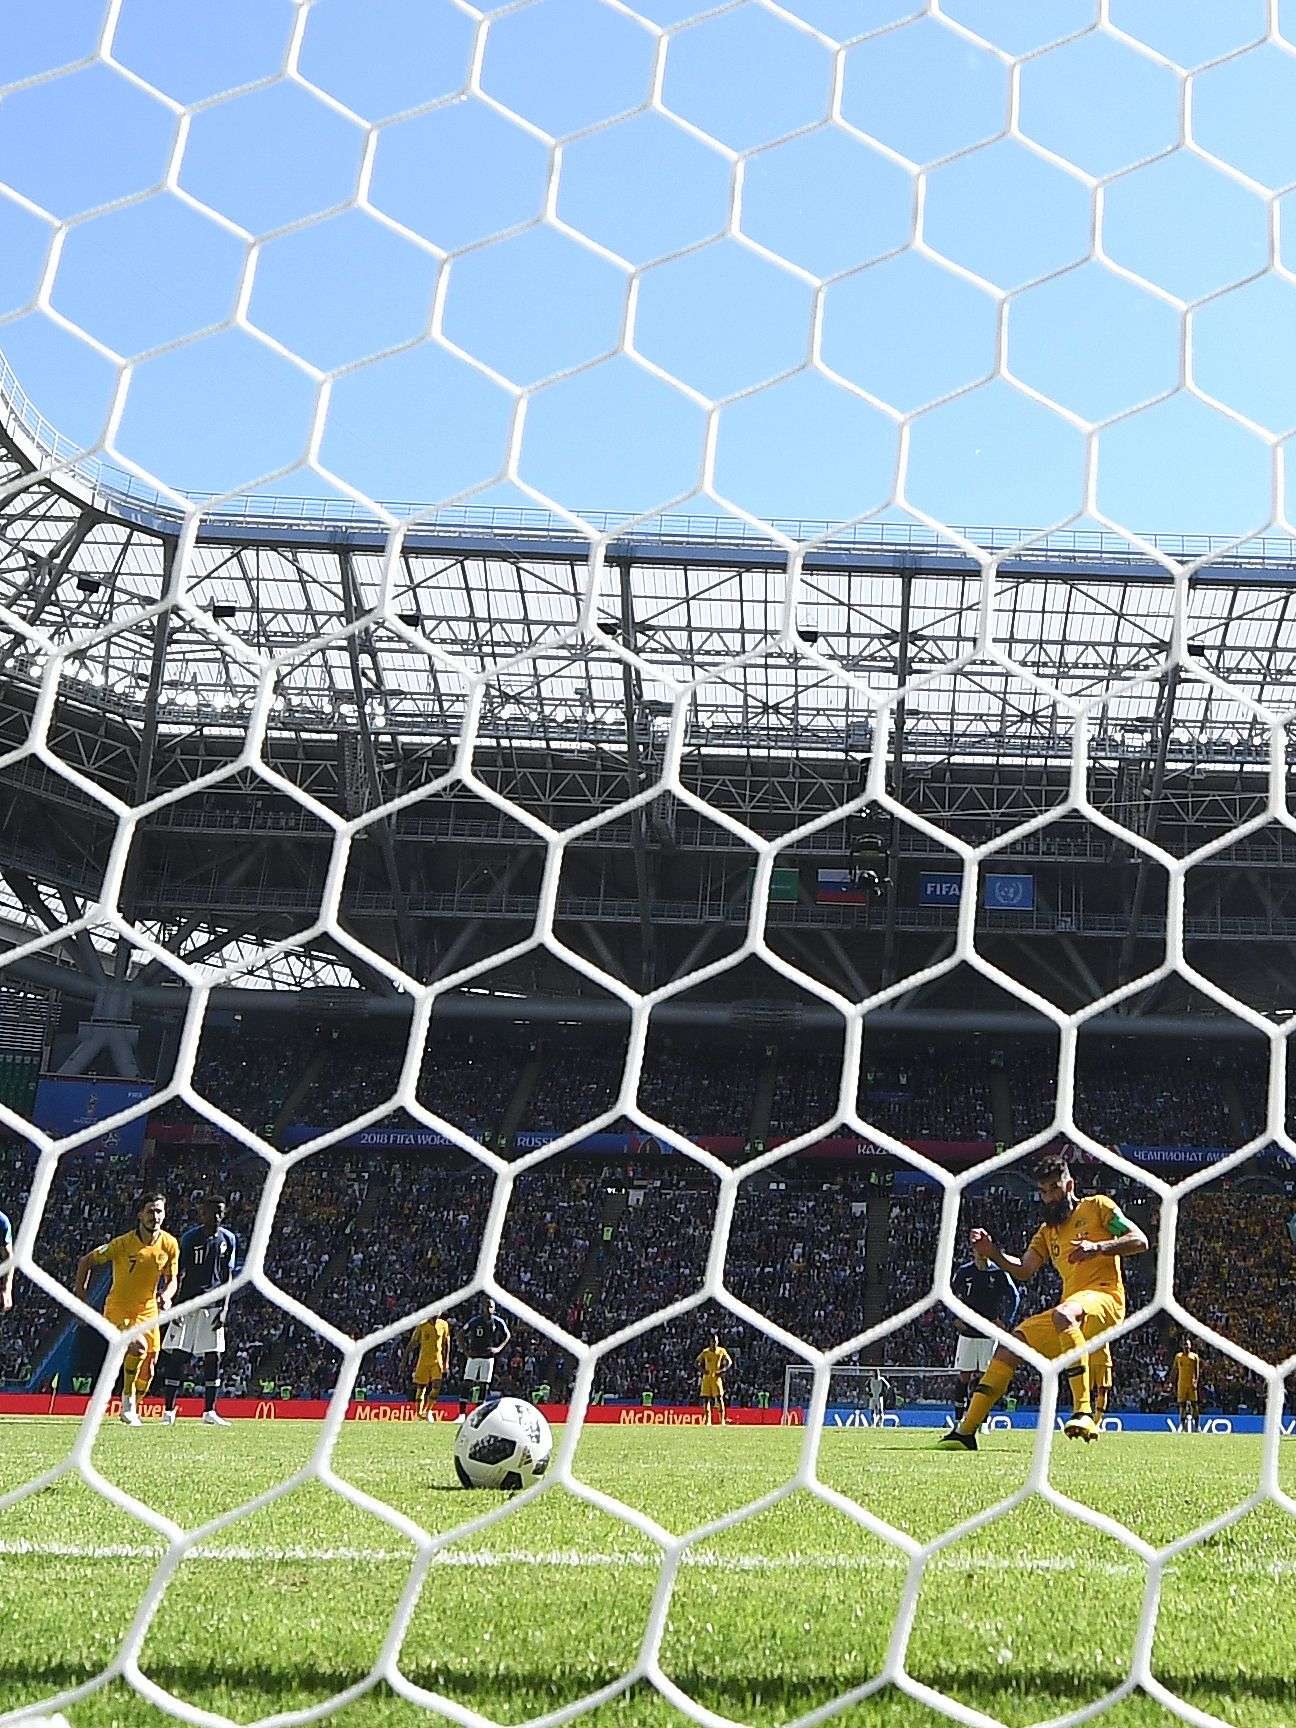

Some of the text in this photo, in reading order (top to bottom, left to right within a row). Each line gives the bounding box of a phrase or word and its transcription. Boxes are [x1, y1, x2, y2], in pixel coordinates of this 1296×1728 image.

[926, 883, 961, 896] FIFA
[360, 1133, 553, 1147] 2018 FIFA WORL RUSS
[194, 1249, 204, 1264] 11
[128, 1257, 137, 1273] 7
[966, 1283, 972, 1296] 7
[355, 1405, 447, 1421] McDelivy
[620, 1409, 708, 1425] McDelivery
[1166, 1414, 1232, 1434] vivo
